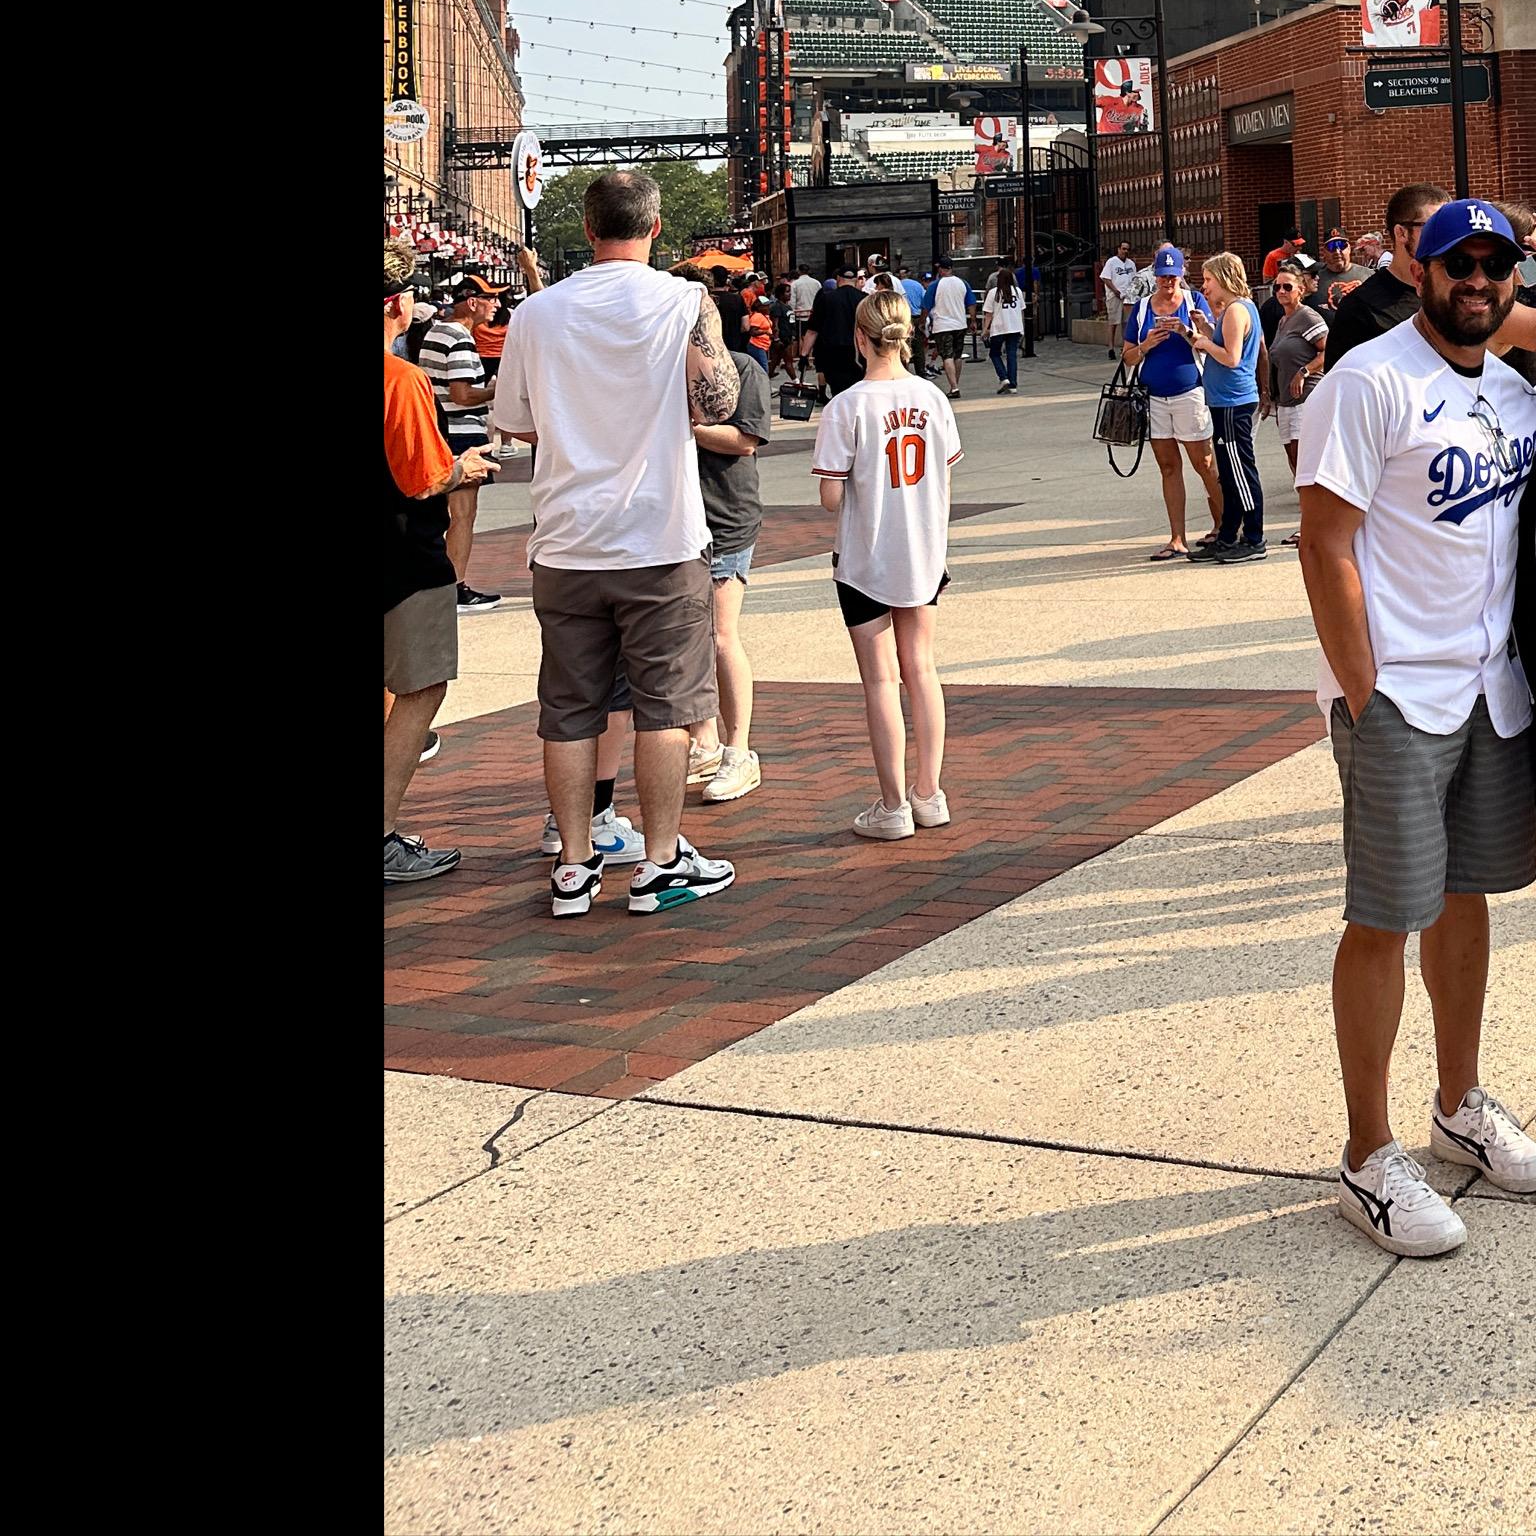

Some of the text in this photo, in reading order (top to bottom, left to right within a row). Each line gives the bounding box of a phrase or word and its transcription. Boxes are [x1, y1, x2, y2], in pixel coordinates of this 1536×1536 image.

[1046, 68, 1084, 79] 5:53:2
[1140, 61, 1150, 85] ADLEY
[1388, 77, 1429, 87] SECTIONS
[1430, 76, 1439, 85] 90
[1388, 87, 1439, 97] BLEACHERS
[1467, 205, 1493, 231] LA
[1165, 254, 1174, 266] LA
[883, 408, 930, 435] JONES
[885, 434, 926, 489] 10
